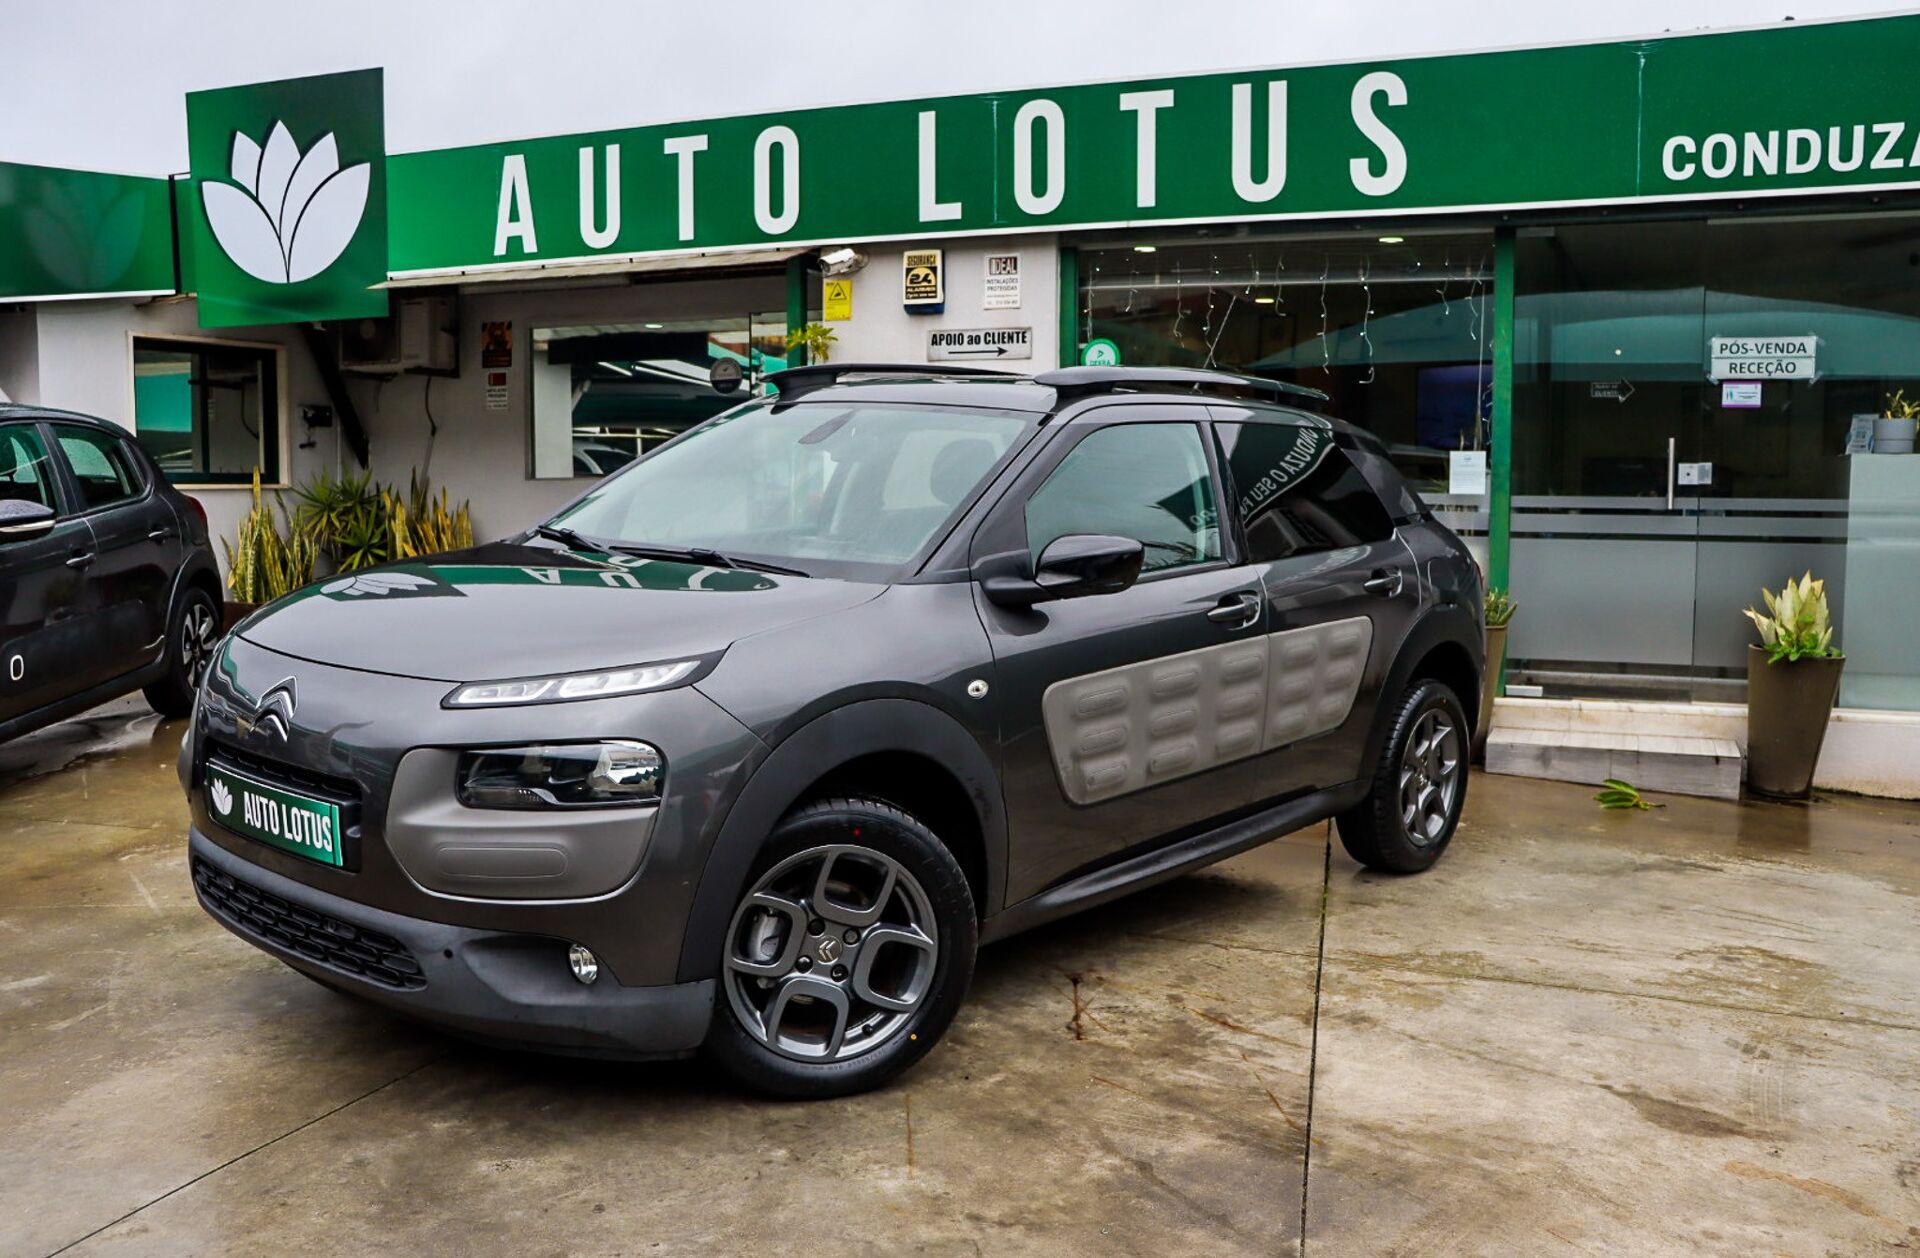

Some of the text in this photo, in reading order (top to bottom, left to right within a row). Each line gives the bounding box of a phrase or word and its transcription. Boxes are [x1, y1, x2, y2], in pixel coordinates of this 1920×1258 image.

[494, 71, 1408, 256] AUTO LOTUS
[1662, 121, 1920, 181] CONDUZ
[931, 331, 1027, 346] APOIO ao CLIENTE
[1720, 340, 1807, 355] PÓS-VENDA
[1729, 359, 1797, 376] RECEÇÃO
[243, 790, 333, 853] AUTO LOTUS
